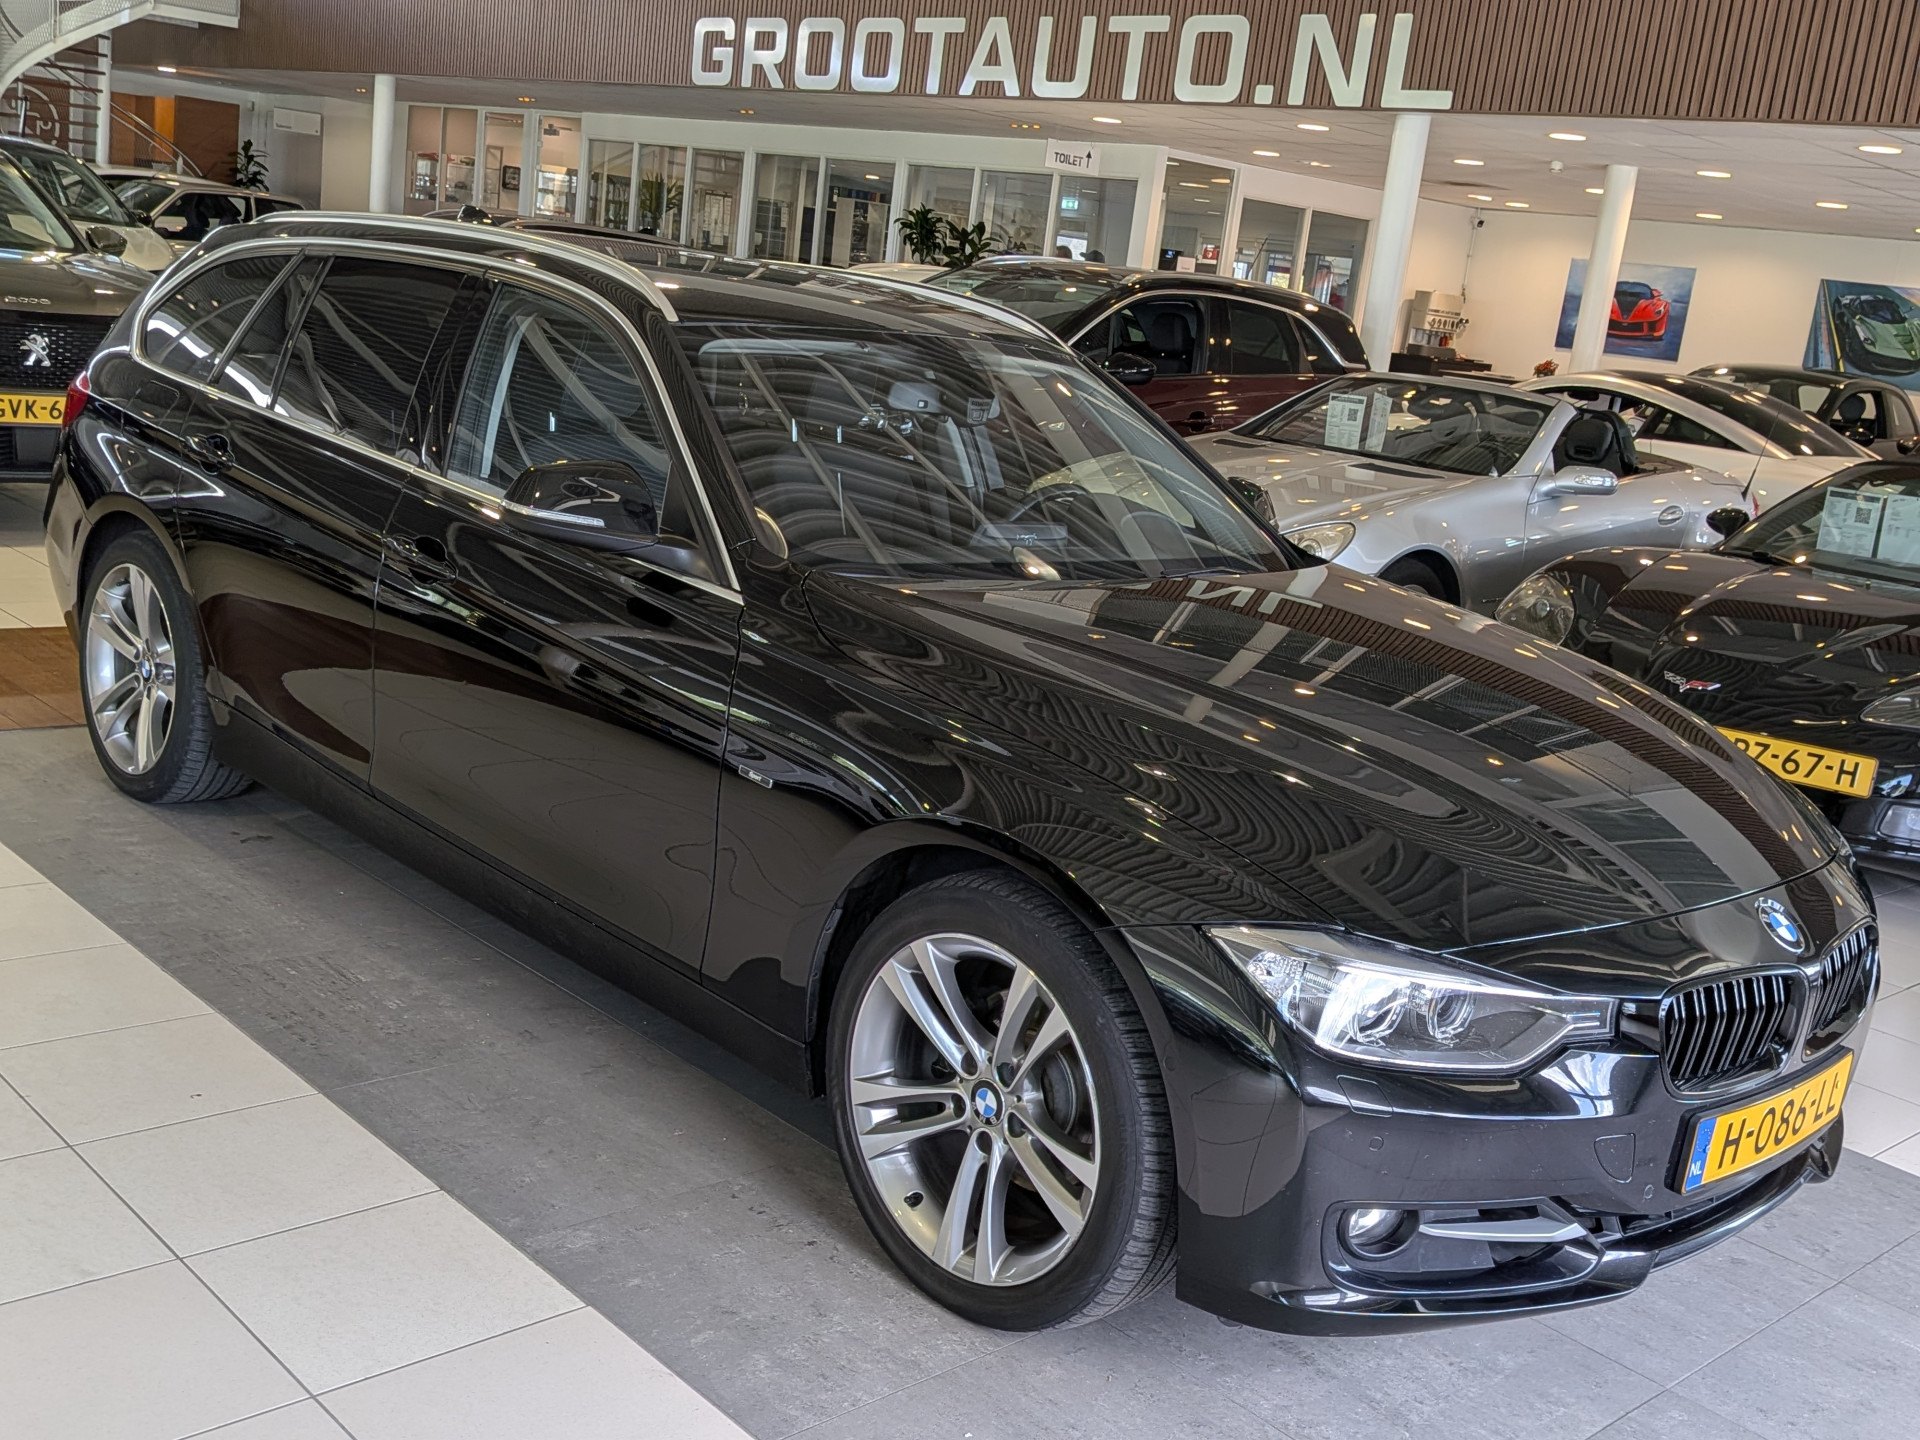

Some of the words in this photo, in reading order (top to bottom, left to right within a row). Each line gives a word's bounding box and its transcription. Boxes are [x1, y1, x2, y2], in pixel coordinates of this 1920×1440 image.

[691, 13, 1454, 110] GROOTAUTO.NL
[1054, 151, 1084, 167] TOILET
[1717, 1071, 1838, 1170] H-086-LL
[1689, 1160, 1702, 1178] NL
